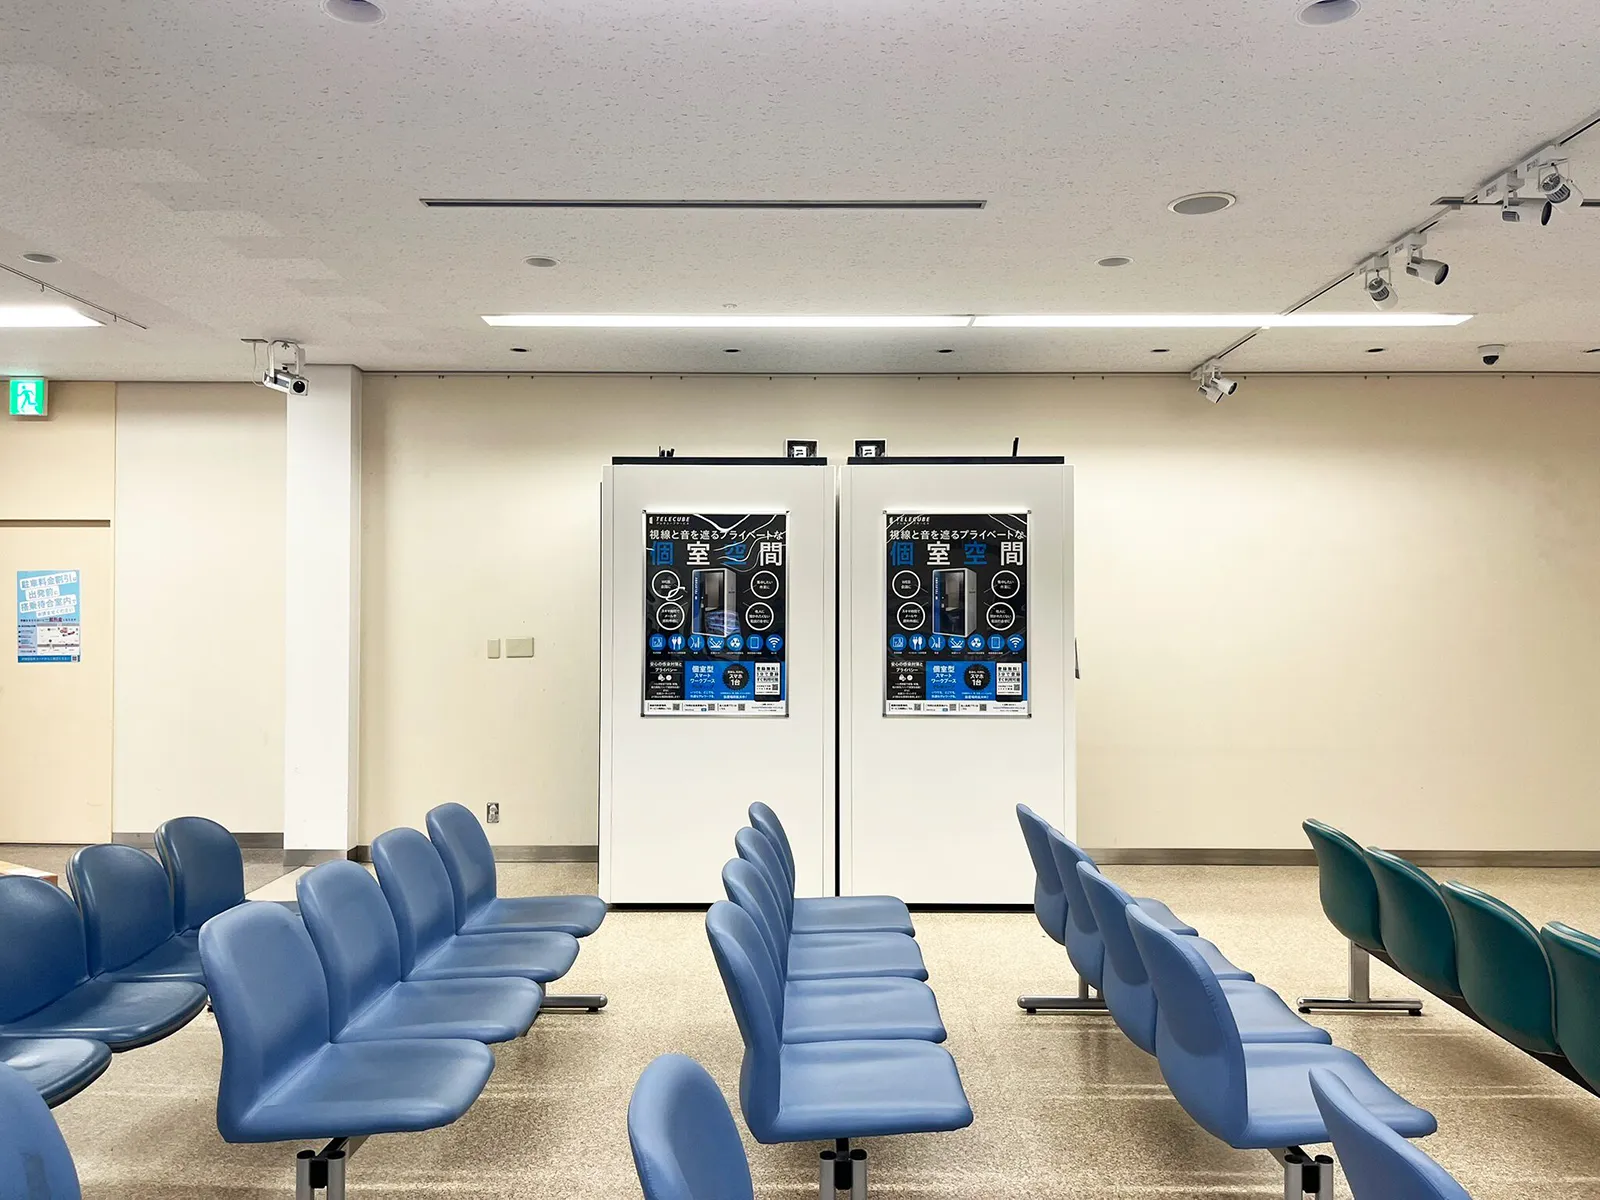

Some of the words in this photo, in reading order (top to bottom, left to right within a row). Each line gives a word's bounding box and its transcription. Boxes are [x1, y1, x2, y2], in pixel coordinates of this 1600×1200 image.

[889, 529, 1024, 540] 視線と音を遮るプライベートな
[890, 541, 1024, 566] 個室空間
[691, 665, 714, 673] 個室型
[933, 665, 955, 673] 個室型
